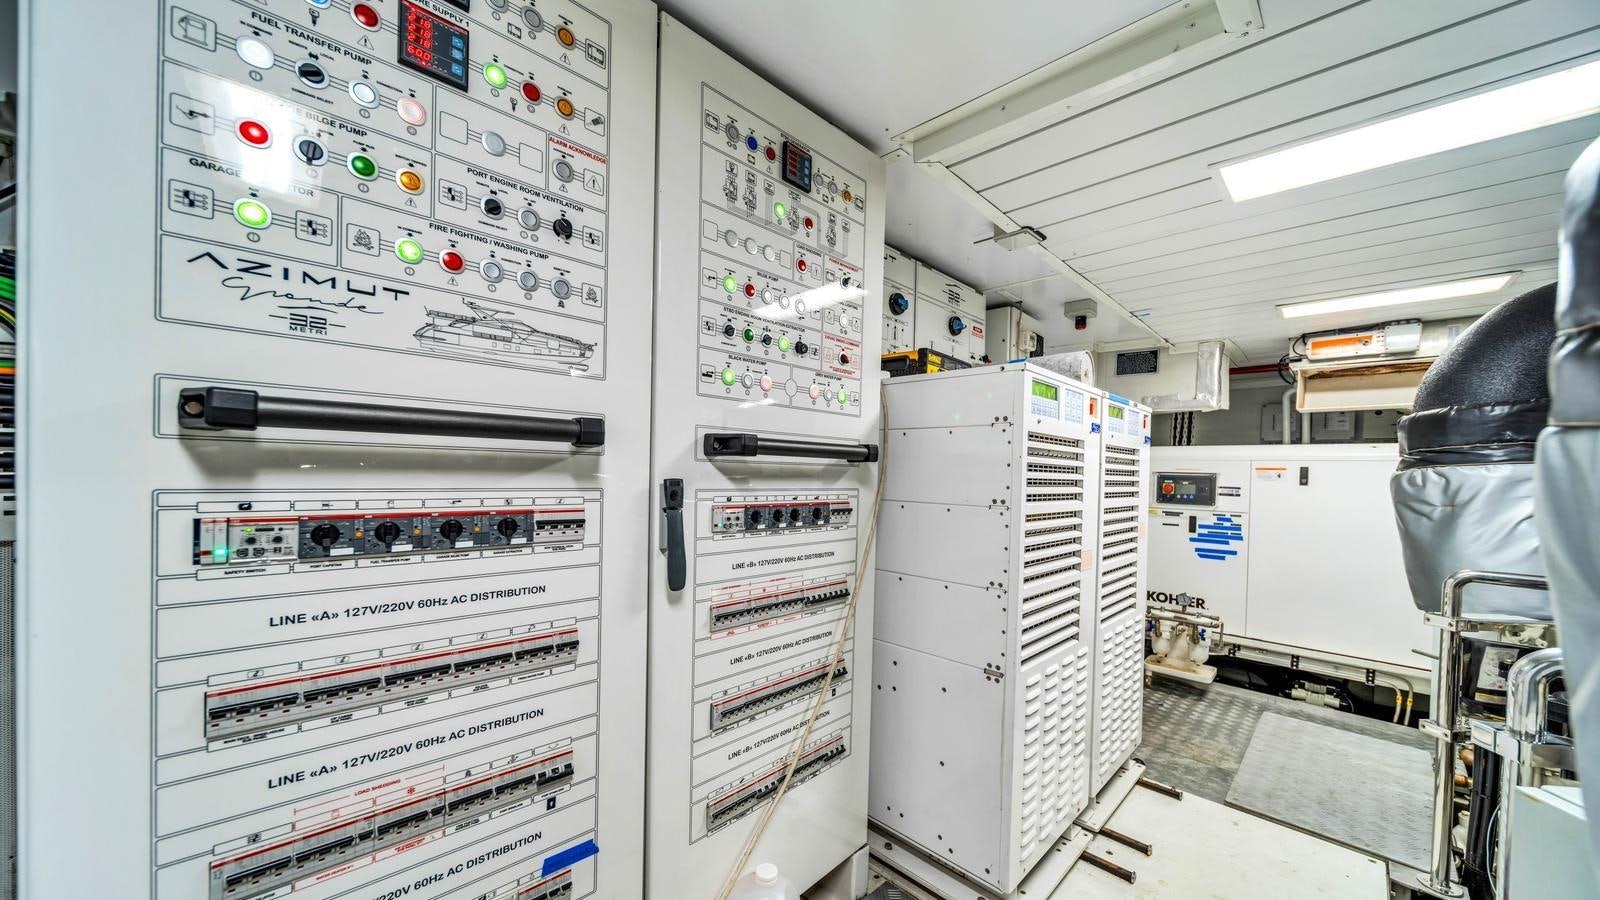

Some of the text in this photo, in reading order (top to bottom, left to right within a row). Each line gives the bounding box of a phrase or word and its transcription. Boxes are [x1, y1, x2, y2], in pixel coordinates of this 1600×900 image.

[432, 4, 463, 24] SUPPLY
[251, 11, 372, 66] FUEL TRANSFER PUMP
[320, 52, 334, 61] LOCAL
[306, 111, 336, 128] BILGE
[339, 123, 367, 138] PUMP
[549, 136, 607, 165] ALARM ACKNOWLEDGE
[189, 158, 241, 178] GARAGE
[467, 167, 584, 213] PORT ENGINE ROOM VENTILATION
[429, 223, 449, 234] FIRE
[450, 228, 488, 244] FIGHTING
[494, 239, 529, 255] WASHING
[530, 249, 549, 261] PUMP
[187, 252, 410, 301] AZIMUT
[222, 276, 384, 315] Grande
[289, 313, 327, 330] 32
[289, 325, 327, 336] METRI
[735, 310, 749, 318] ENGINE
[763, 318, 785, 327] VENTILATION
[786, 322, 805, 332] EXTRACTOR
[732, 562, 746, 570] LINE
[758, 557, 783, 567] 127V/220V
[784, 555, 796, 563] 60Hz
[804, 551, 835, 561] DISTRIBUTION
[269, 585, 546, 627] LINE «A» 127V/220V 60Hz AC DISTRIBUTION
[1146, 590, 1206, 610] KOHER
[730, 656, 744, 665] LINE
[744, 653, 755, 661] «B»
[756, 645, 782, 658] 127V/220V
[782, 642, 794, 650] 60Hz
[801, 631, 832, 645] DISTRIBUTION
[268, 709, 544, 789] LINE «A» 127V/220V 60Hz AC DISTRIBUTION
[728, 750, 742, 761] LINE
[742, 744, 753, 754] «B»
[753, 732, 780, 749] 127V/220V
[780, 728, 792, 737] 60Hz
[792, 723, 799, 731] AC
[354, 779, 401, 796] LOAD SHEDDING
[414, 873, 444, 890] 60Hz
[447, 864, 463, 877] AC
[466, 831, 542, 869] DISTRIBUTION
